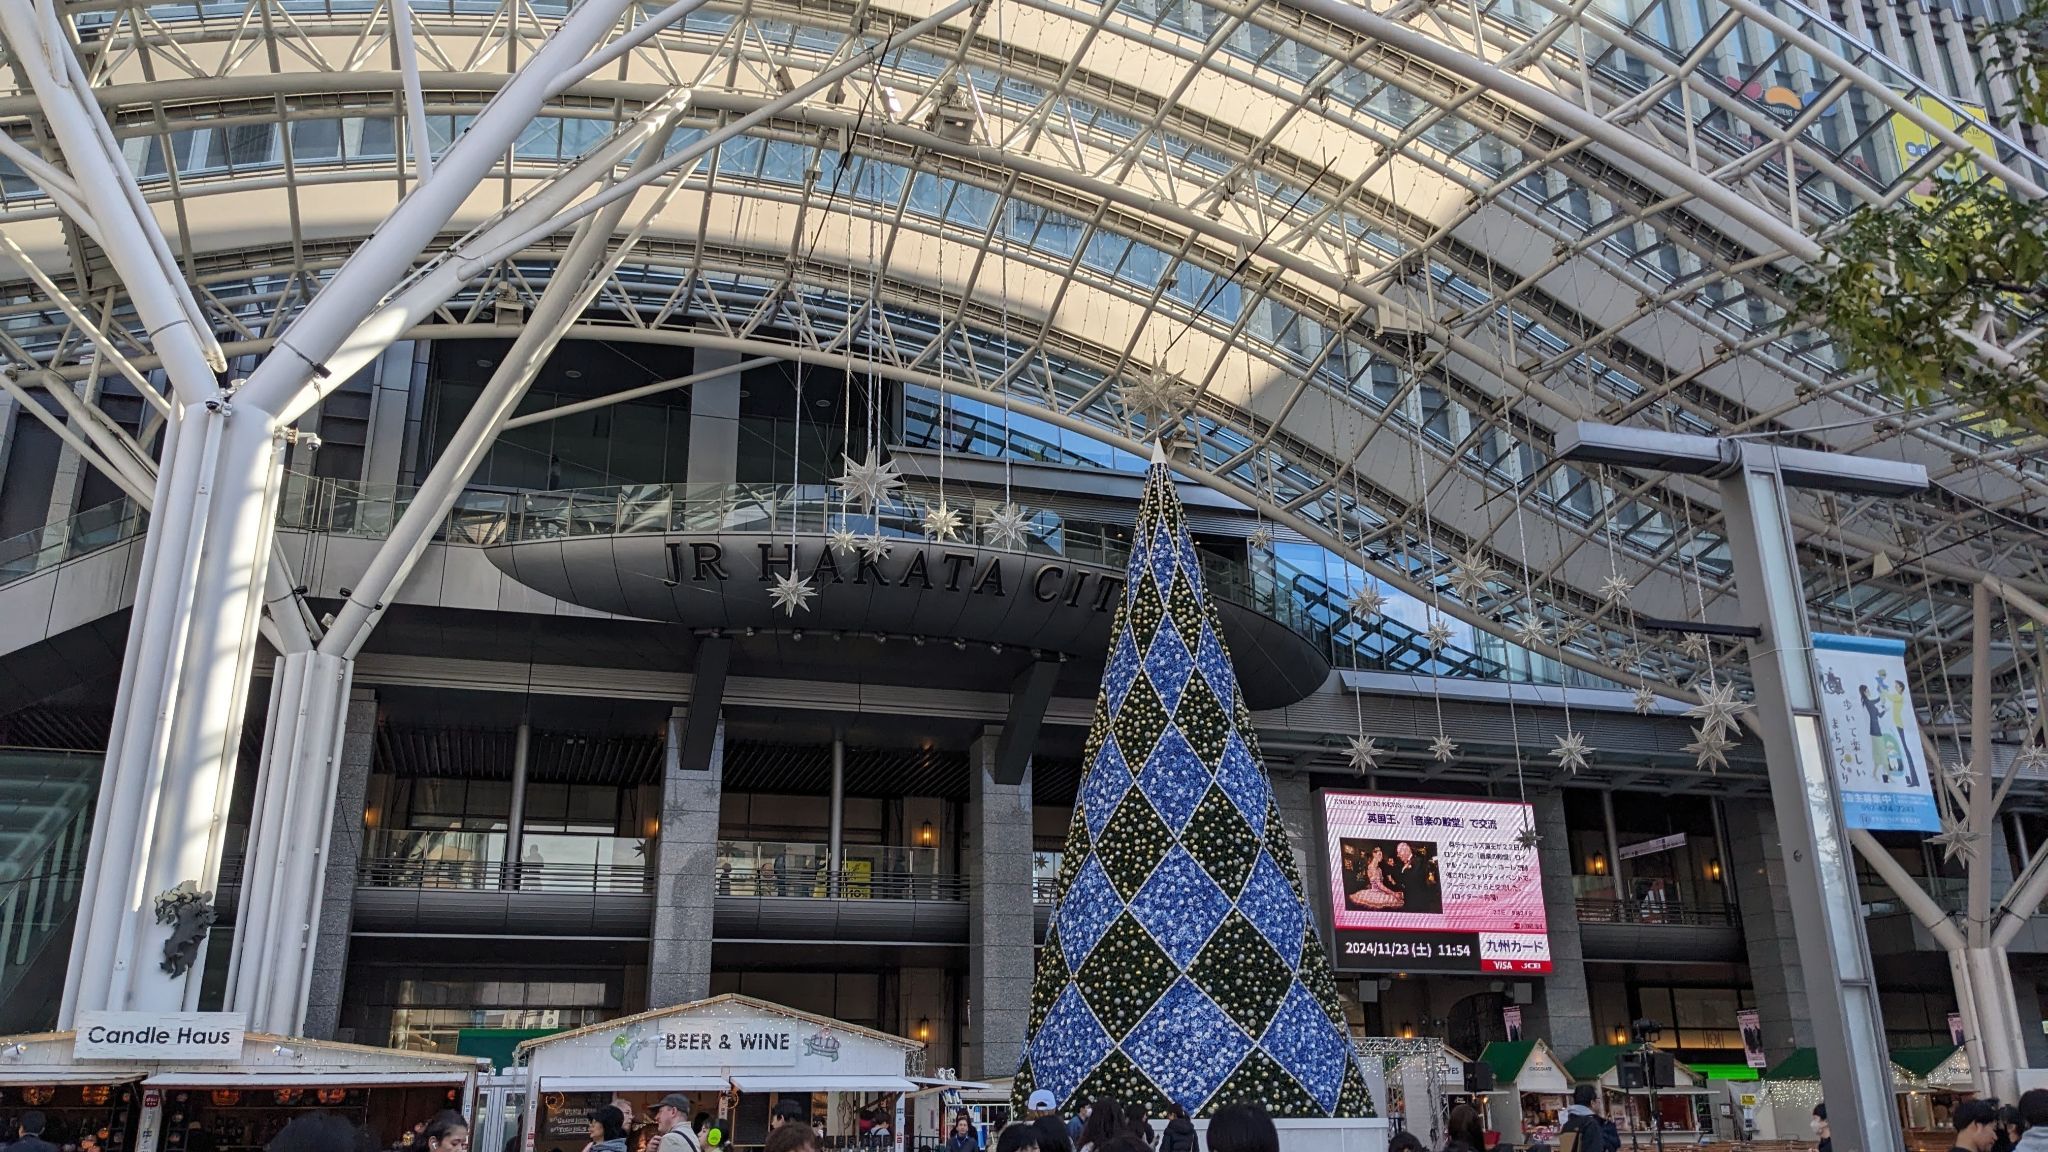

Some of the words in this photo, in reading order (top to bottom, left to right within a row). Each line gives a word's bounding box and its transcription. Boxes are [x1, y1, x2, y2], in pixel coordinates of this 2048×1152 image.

[664, 541, 728, 588] JR
[757, 542, 1006, 597] HAKATA
[1033, 562, 1123, 613] CIT
[1832, 717, 1849, 784] まちづくり
[1438, 944, 1471, 956] 11:54
[1486, 939, 1543, 953] 九州カード
[1493, 961, 1512, 969] VISA
[88, 1026, 170, 1044] Candle
[177, 1027, 230, 1044] Haus
[666, 1033, 712, 1050] BEER
[718, 1034, 732, 1050] &
[739, 1033, 790, 1050] WINE
